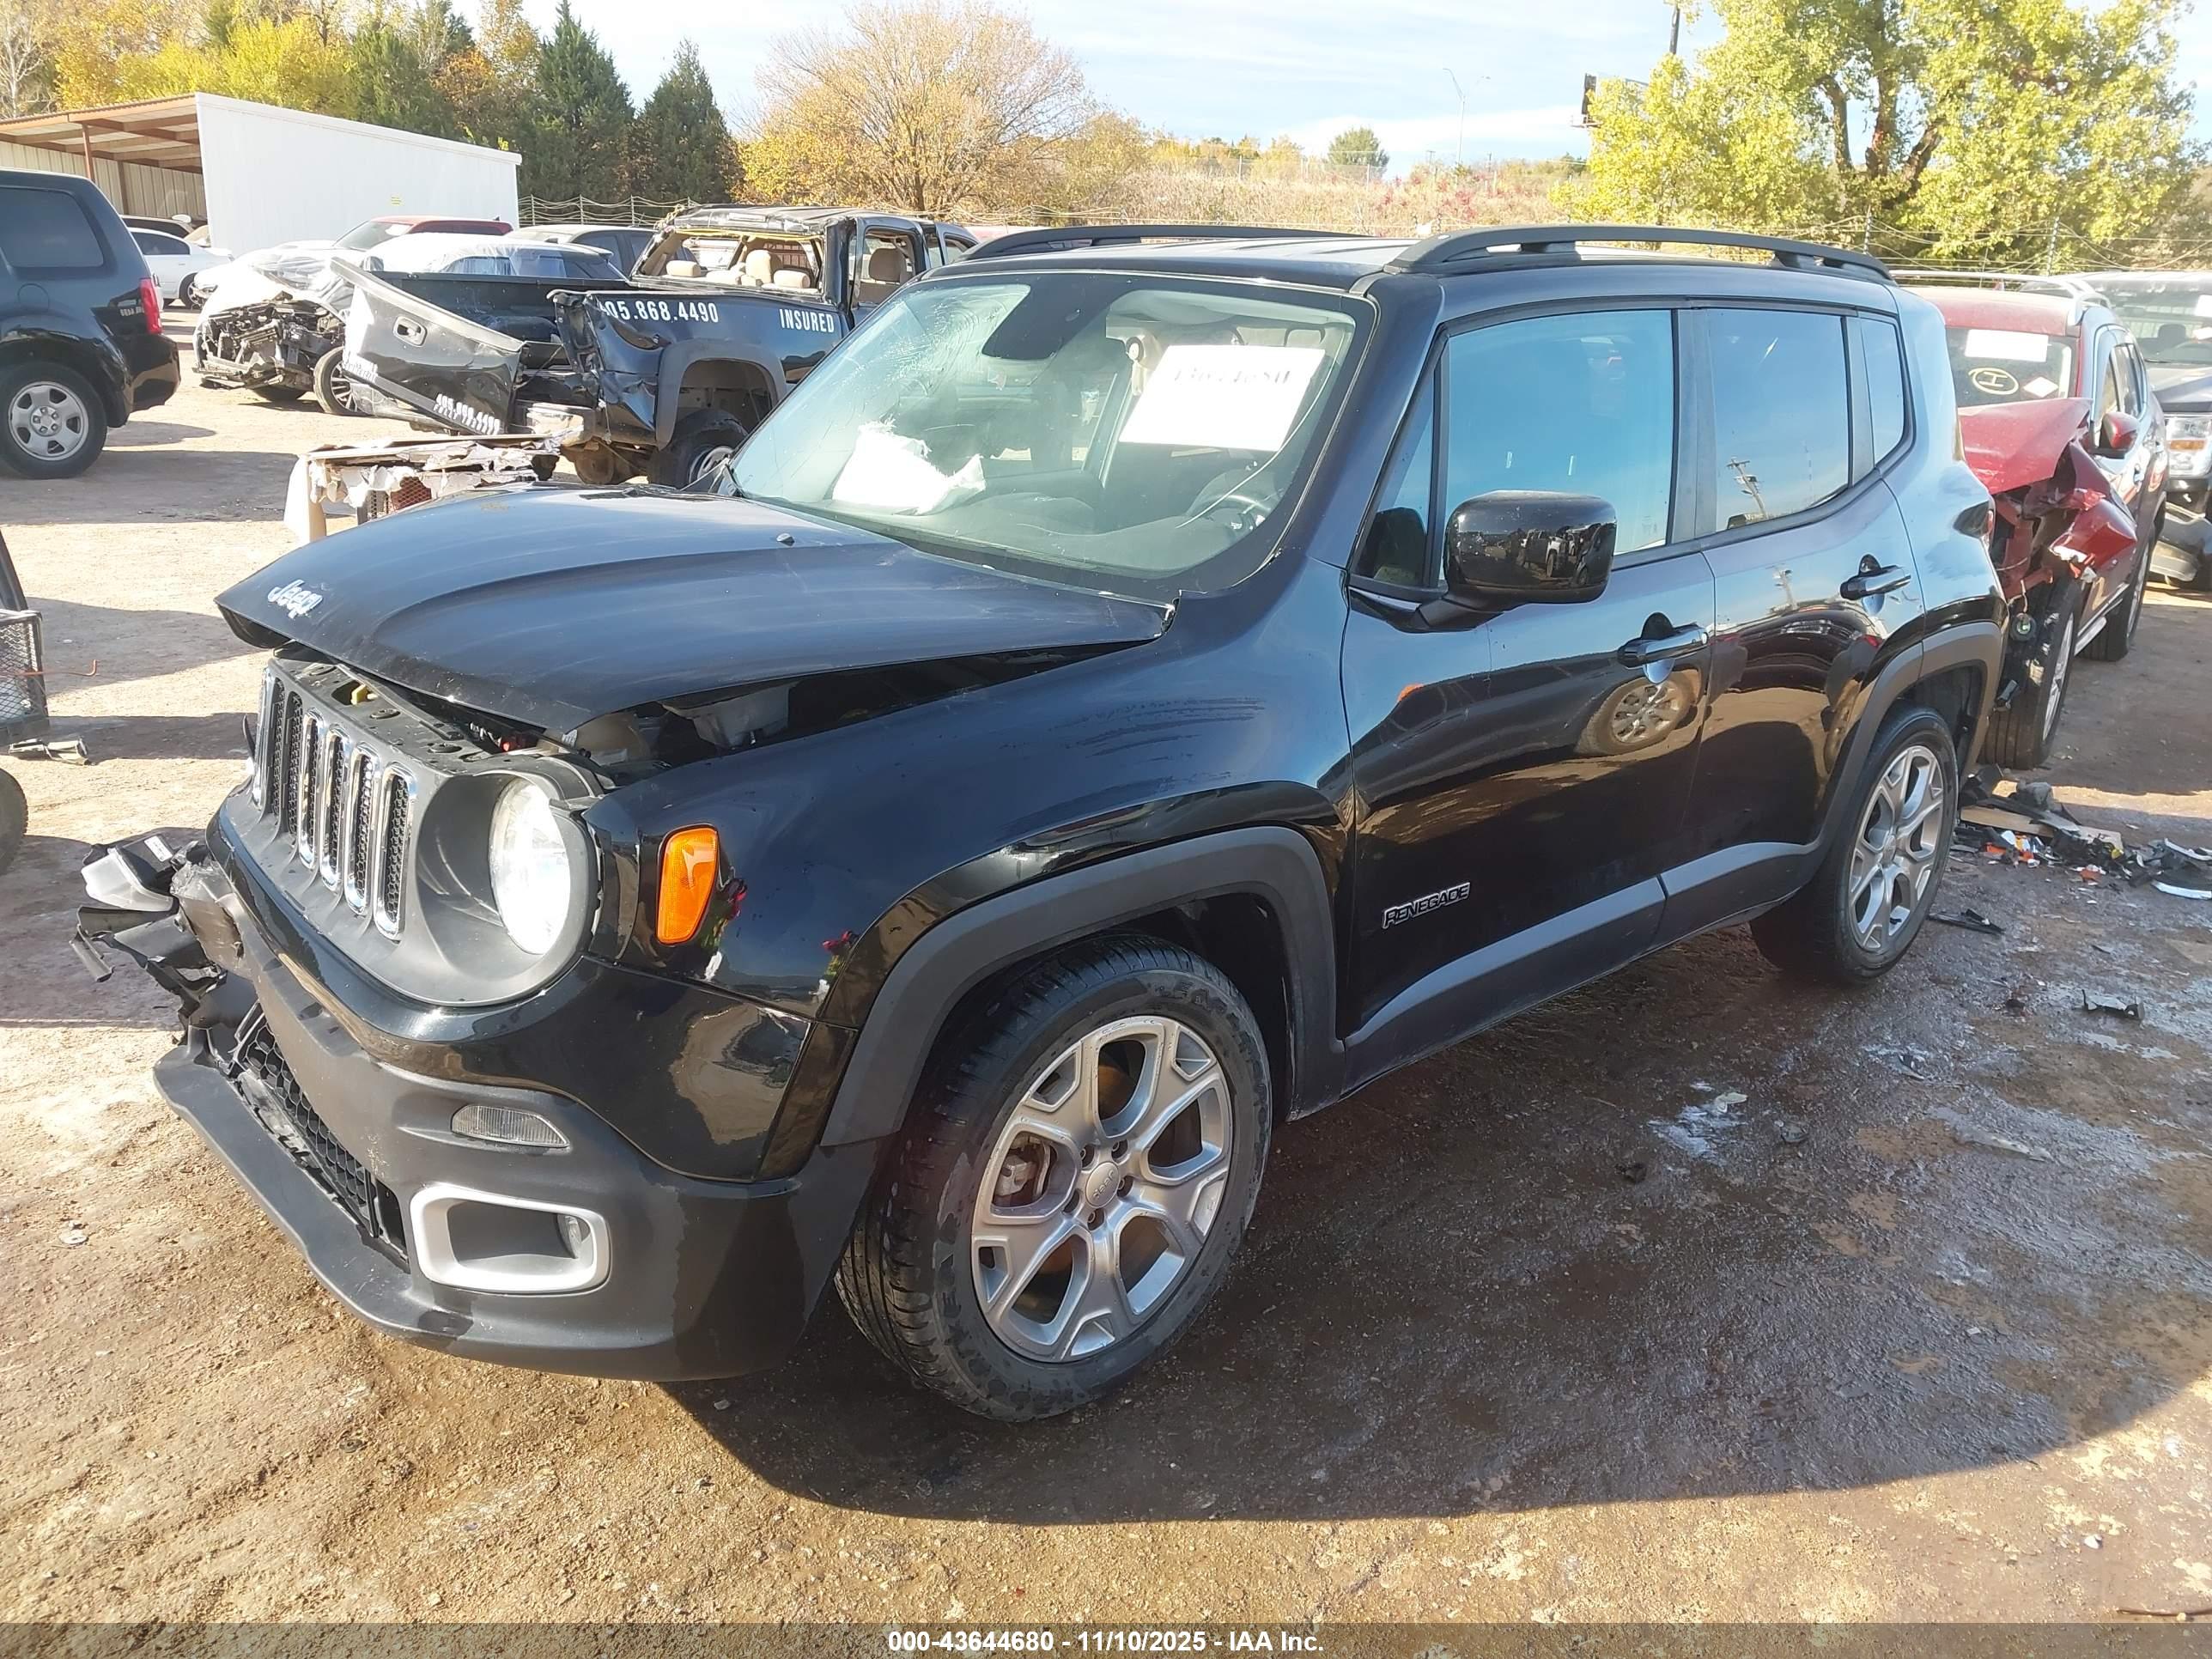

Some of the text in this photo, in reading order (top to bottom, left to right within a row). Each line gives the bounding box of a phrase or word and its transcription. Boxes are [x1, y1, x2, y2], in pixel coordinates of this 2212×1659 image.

[779, 308, 835, 333] INSURED
[267, 579, 324, 619] Jeep
[1382, 882, 1471, 929] RENEGADE
